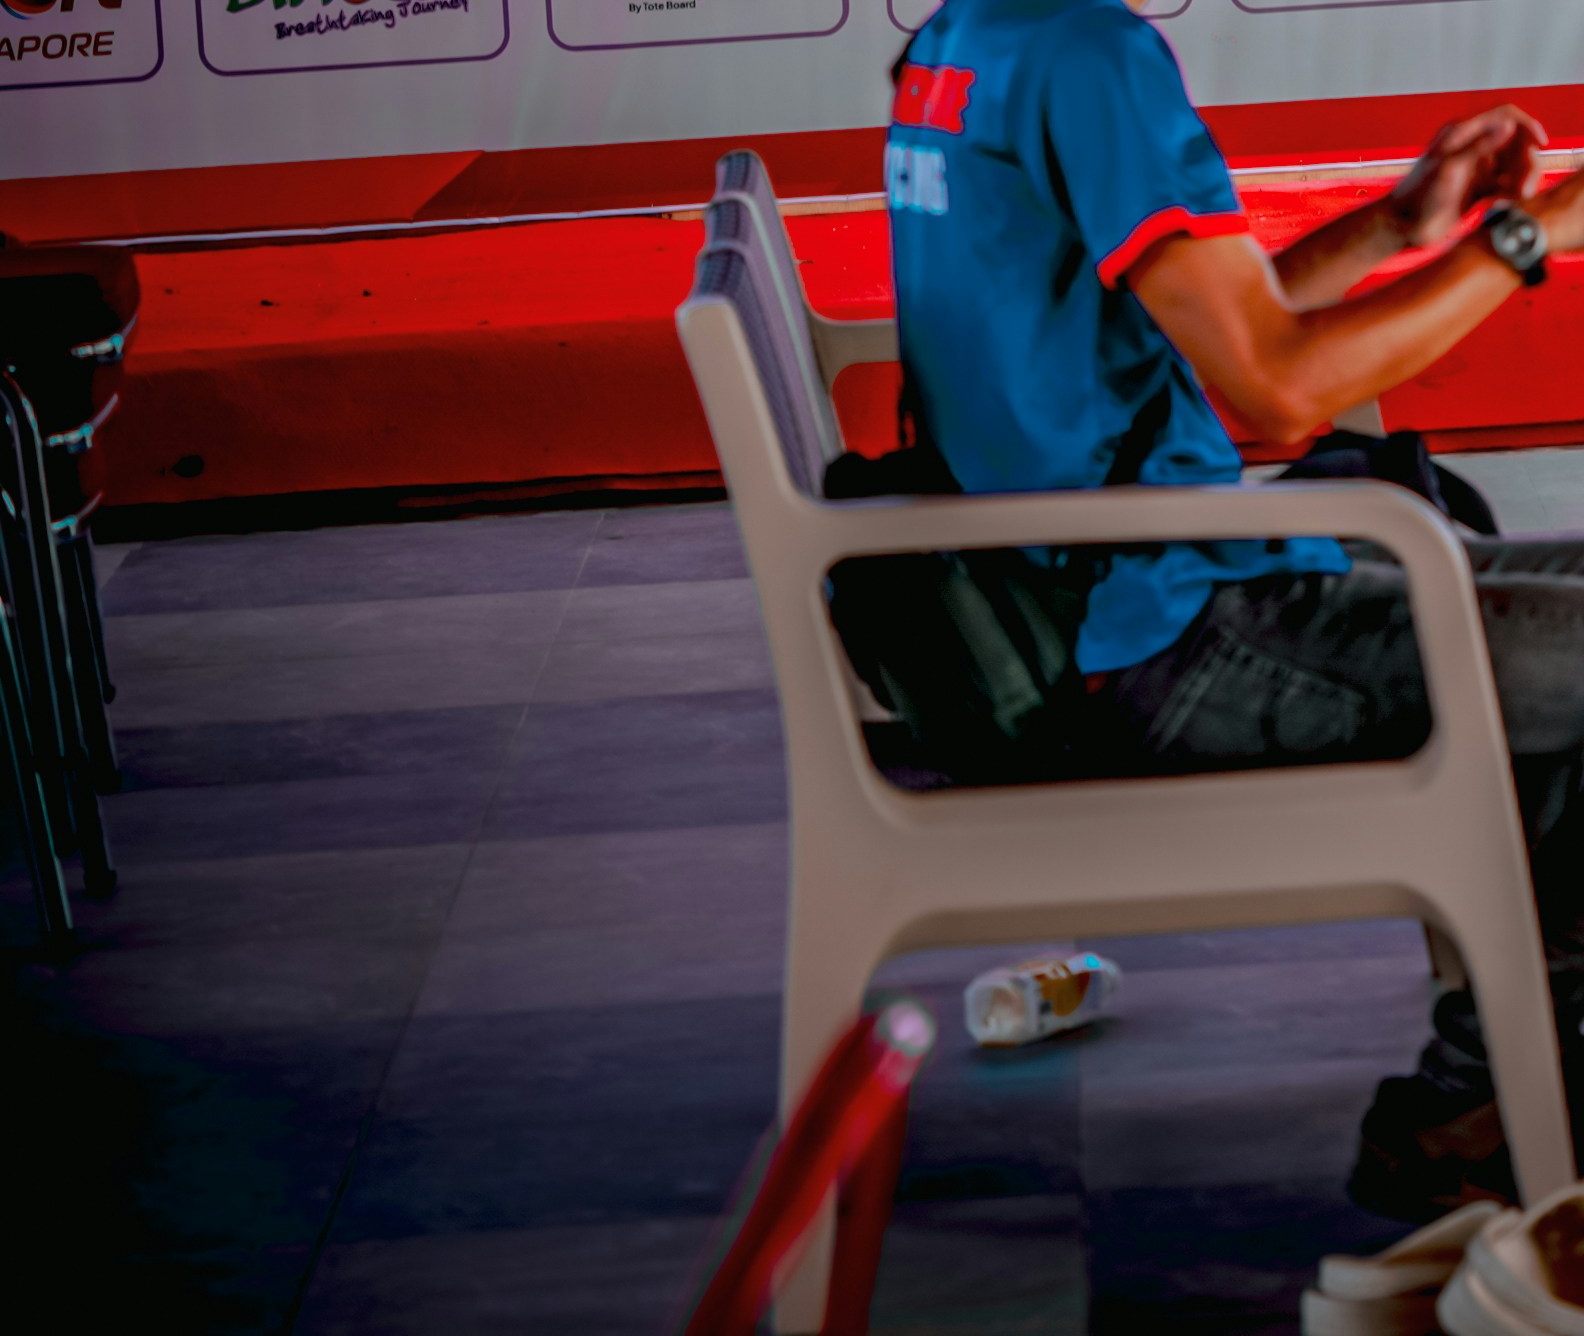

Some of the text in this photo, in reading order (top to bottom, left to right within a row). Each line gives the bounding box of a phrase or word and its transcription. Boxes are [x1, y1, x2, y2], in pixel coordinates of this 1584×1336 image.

[629, 0, 695, 13] By Tote Board
[274, 9, 395, 39] Breathtaking
